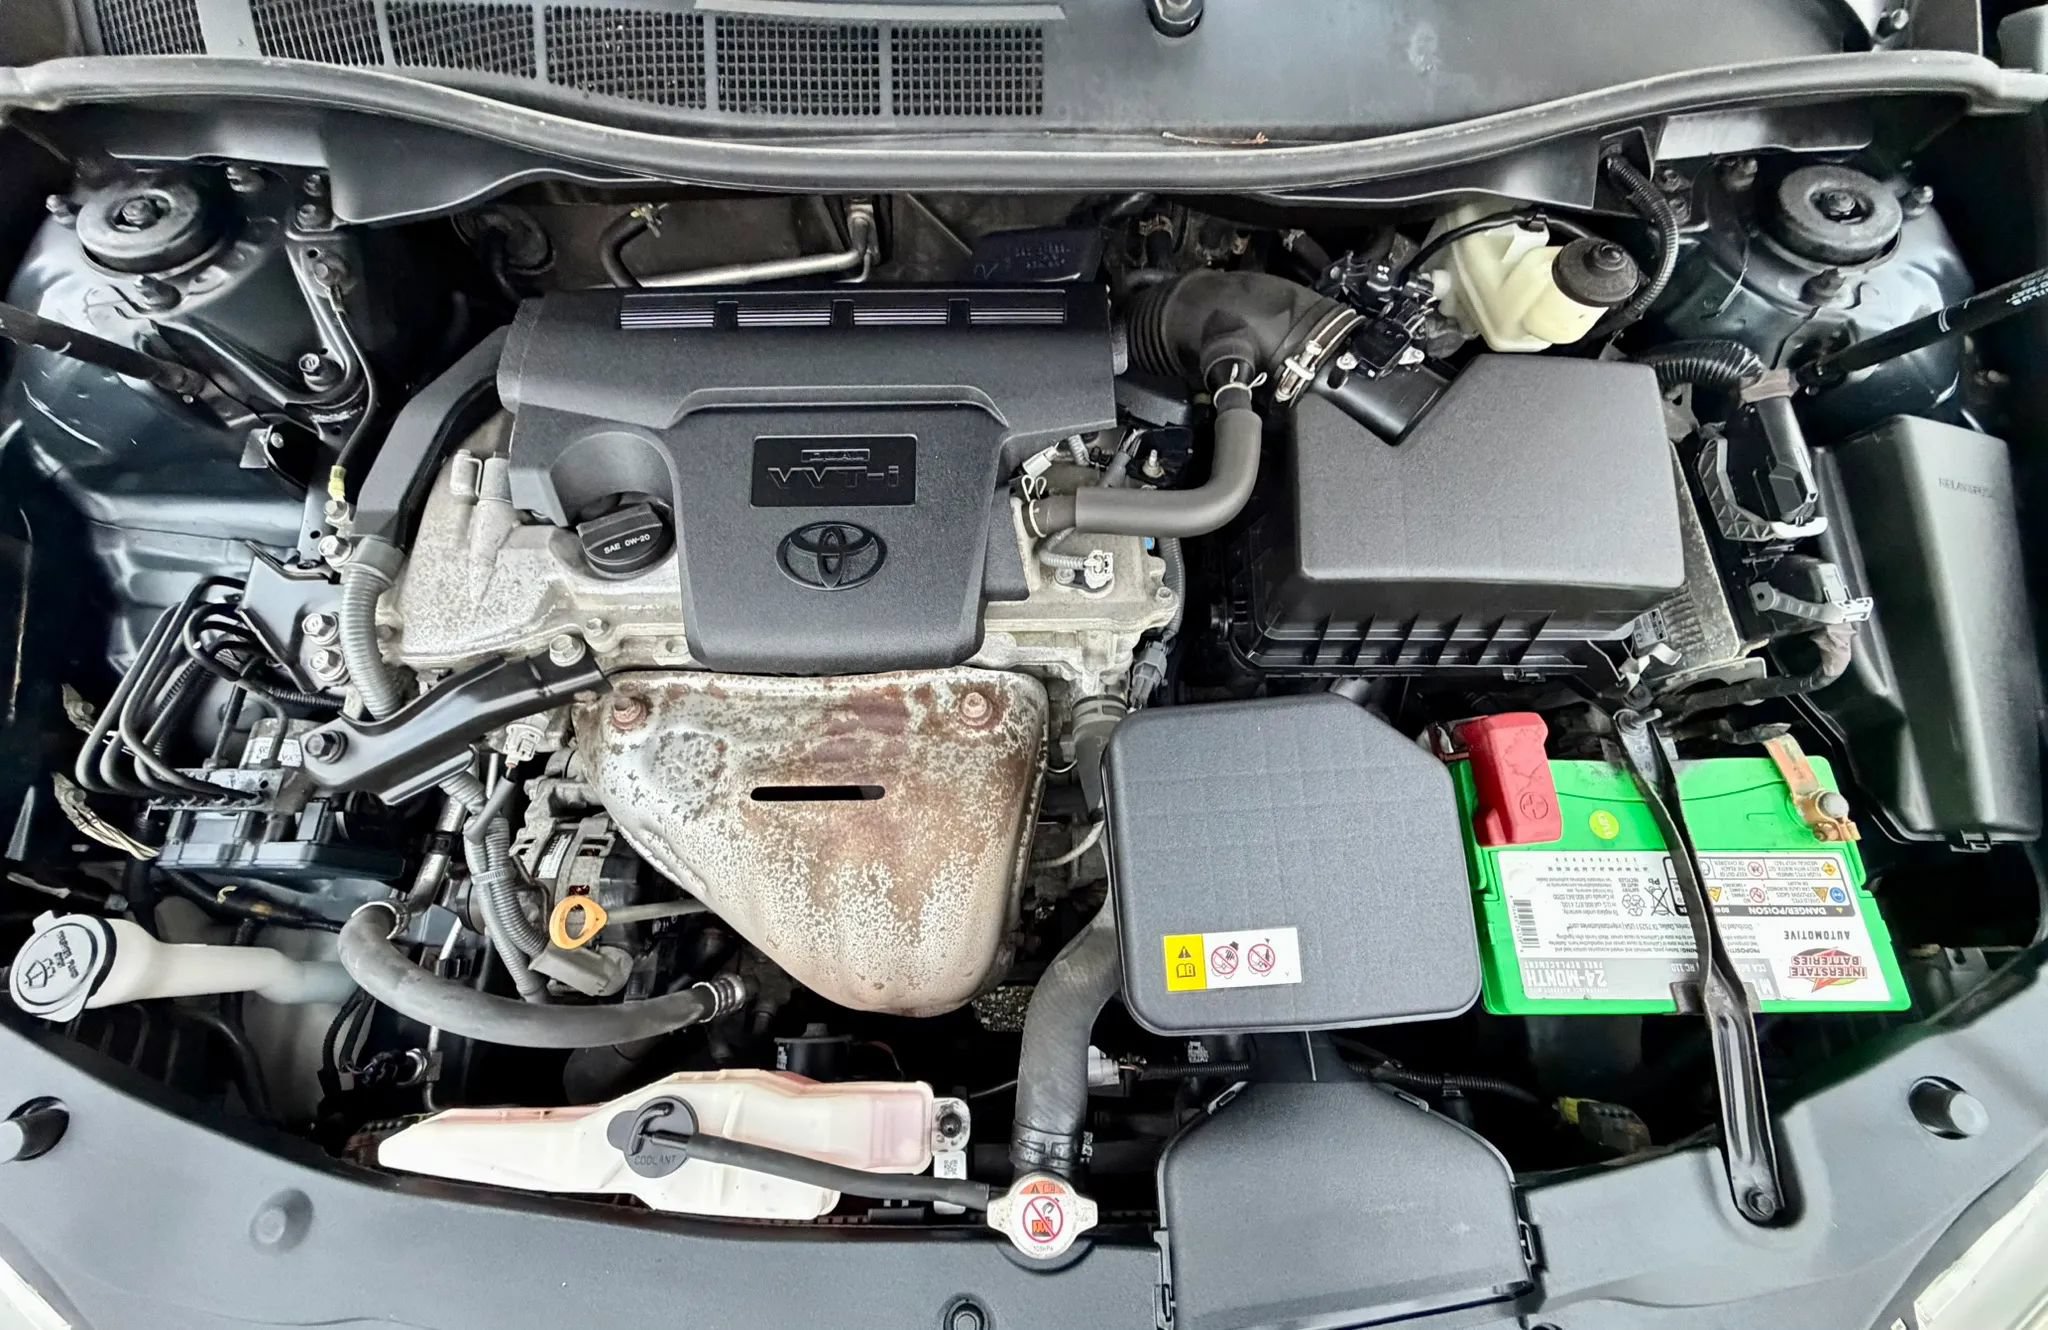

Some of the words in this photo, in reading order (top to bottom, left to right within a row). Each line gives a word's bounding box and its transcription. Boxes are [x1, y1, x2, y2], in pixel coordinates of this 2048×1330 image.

[767, 465, 900, 489] VVT-i
[603, 542, 621, 554] SAE
[624, 533, 651, 547] 0W-20
[1648, 878, 1660, 886] Pb
[1748, 906, 1827, 914] DANGER/POISON
[1783, 930, 1851, 940] AUTOMOTIVE
[1524, 960, 1581, 969] REPLACEMENT
[1584, 960, 1604, 969] FREE
[1792, 956, 1860, 966] BATTERIES
[1670, 963, 1682, 972] 110
[1683, 963, 1696, 972] RC
[1791, 966, 1867, 978] INTERSTATE
[1525, 970, 1608, 987] 24-MONTH
[634, 1154, 677, 1166] COOLANT
